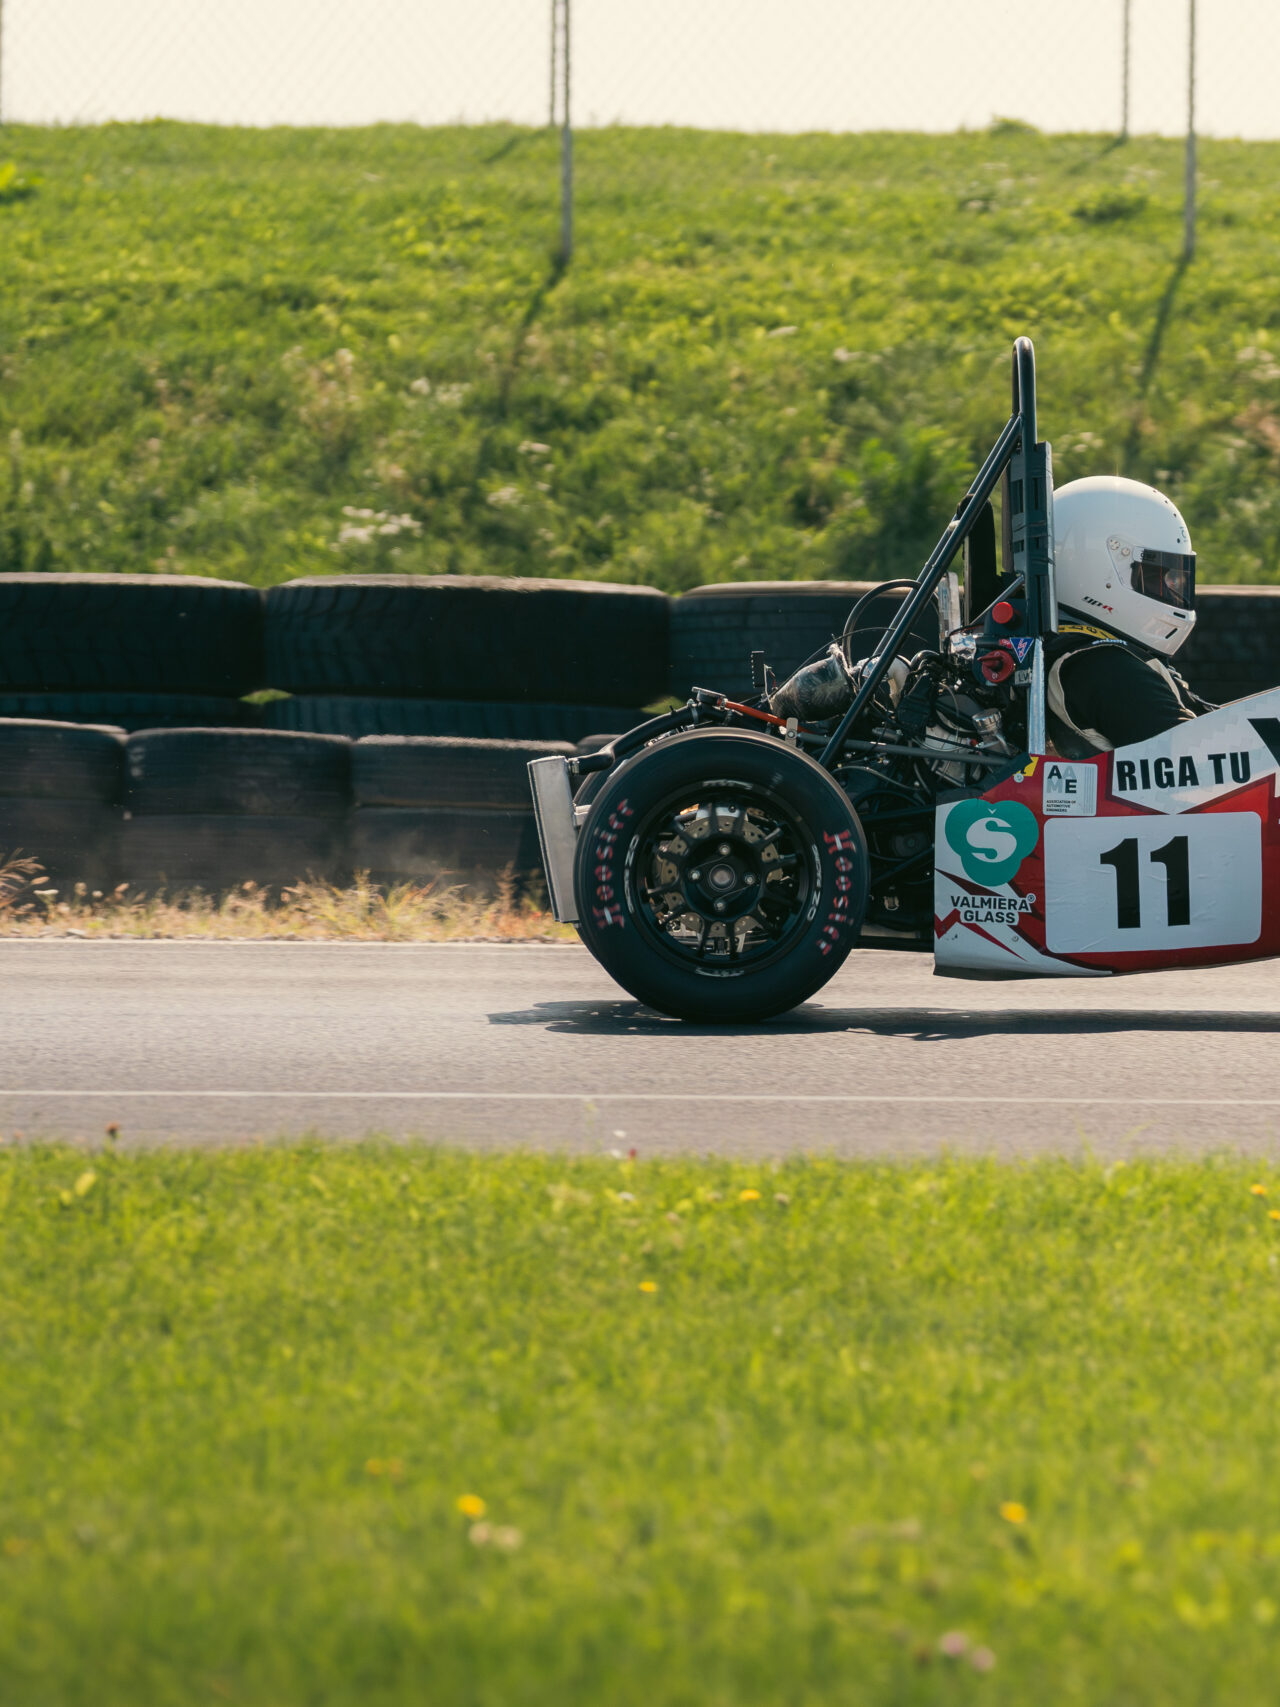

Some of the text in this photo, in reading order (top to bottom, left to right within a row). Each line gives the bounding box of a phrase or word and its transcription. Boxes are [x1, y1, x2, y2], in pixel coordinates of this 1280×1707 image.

[1116, 751, 1250, 792] RIGA TU
[1100, 835, 1191, 929] 11
[950, 895, 1030, 911] VALMIERA
[963, 910, 1016, 924] GLASS
